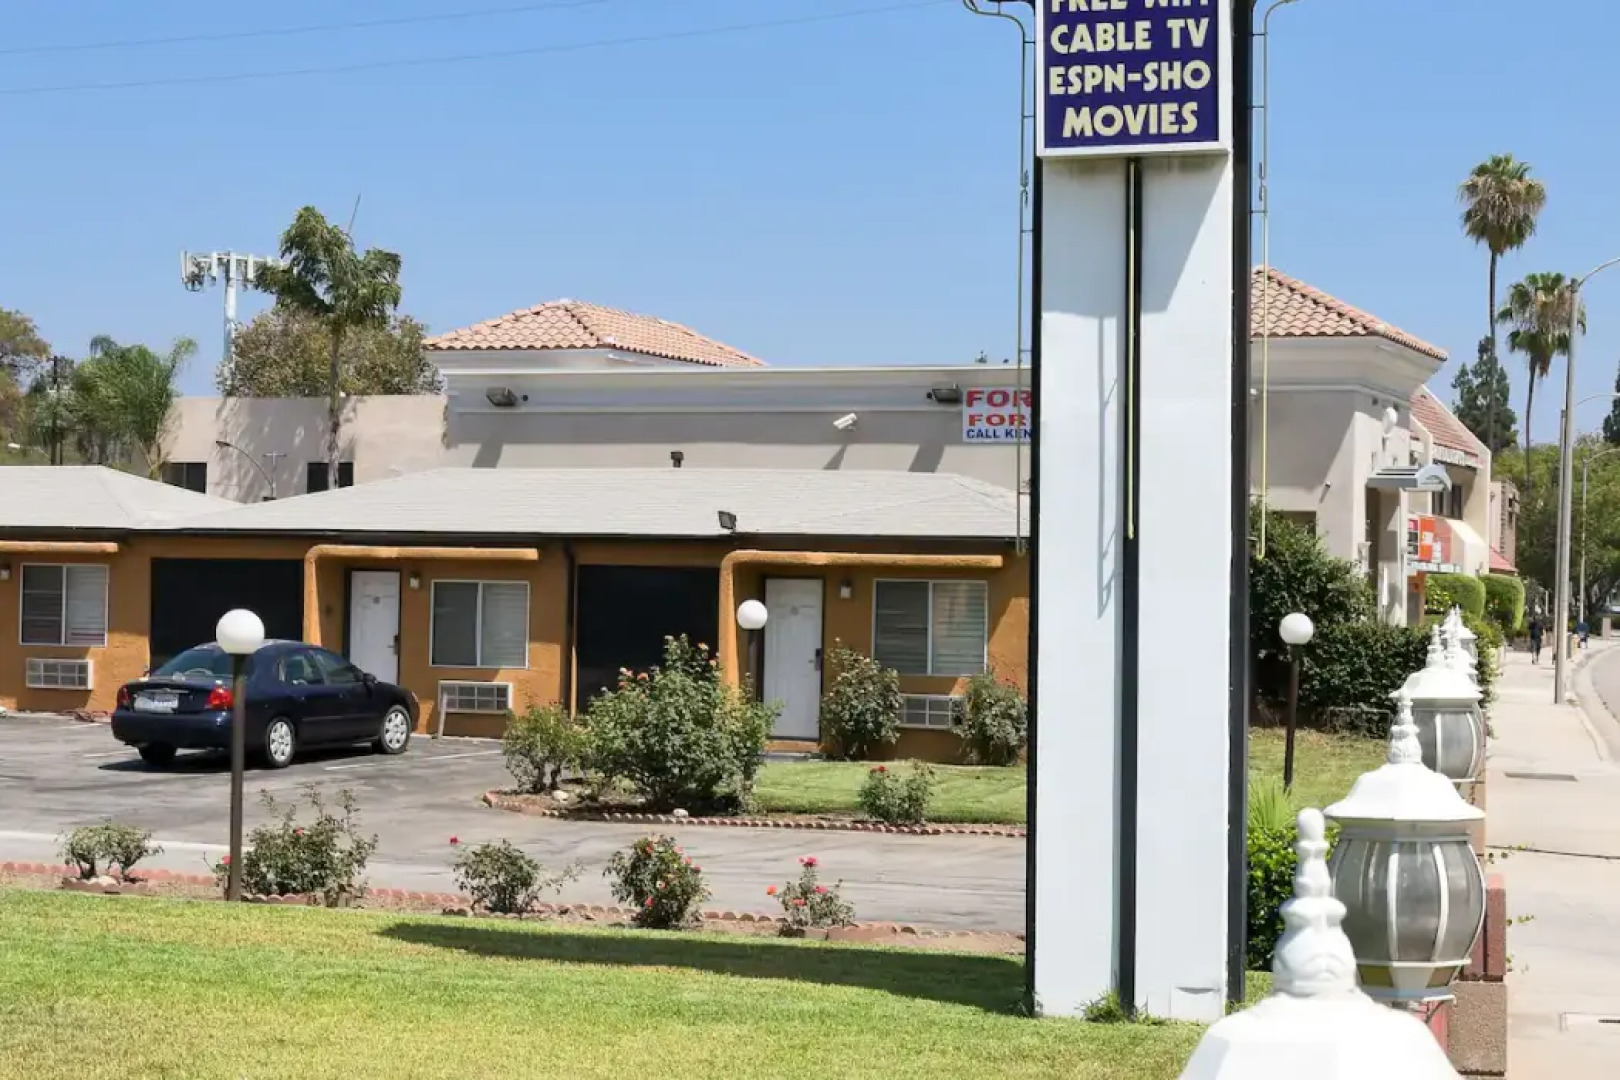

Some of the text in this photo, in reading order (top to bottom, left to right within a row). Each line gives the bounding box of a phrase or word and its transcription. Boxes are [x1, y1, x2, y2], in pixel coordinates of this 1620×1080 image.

[1050, 17, 1209, 54] CABLE TV
[1049, 59, 1211, 95] ESPN-SHO
[1062, 101, 1198, 138] MOVIES
[965, 389, 1032, 408] FOR
[966, 428, 1000, 439] CALL
[968, 413, 1027, 427] FOR
